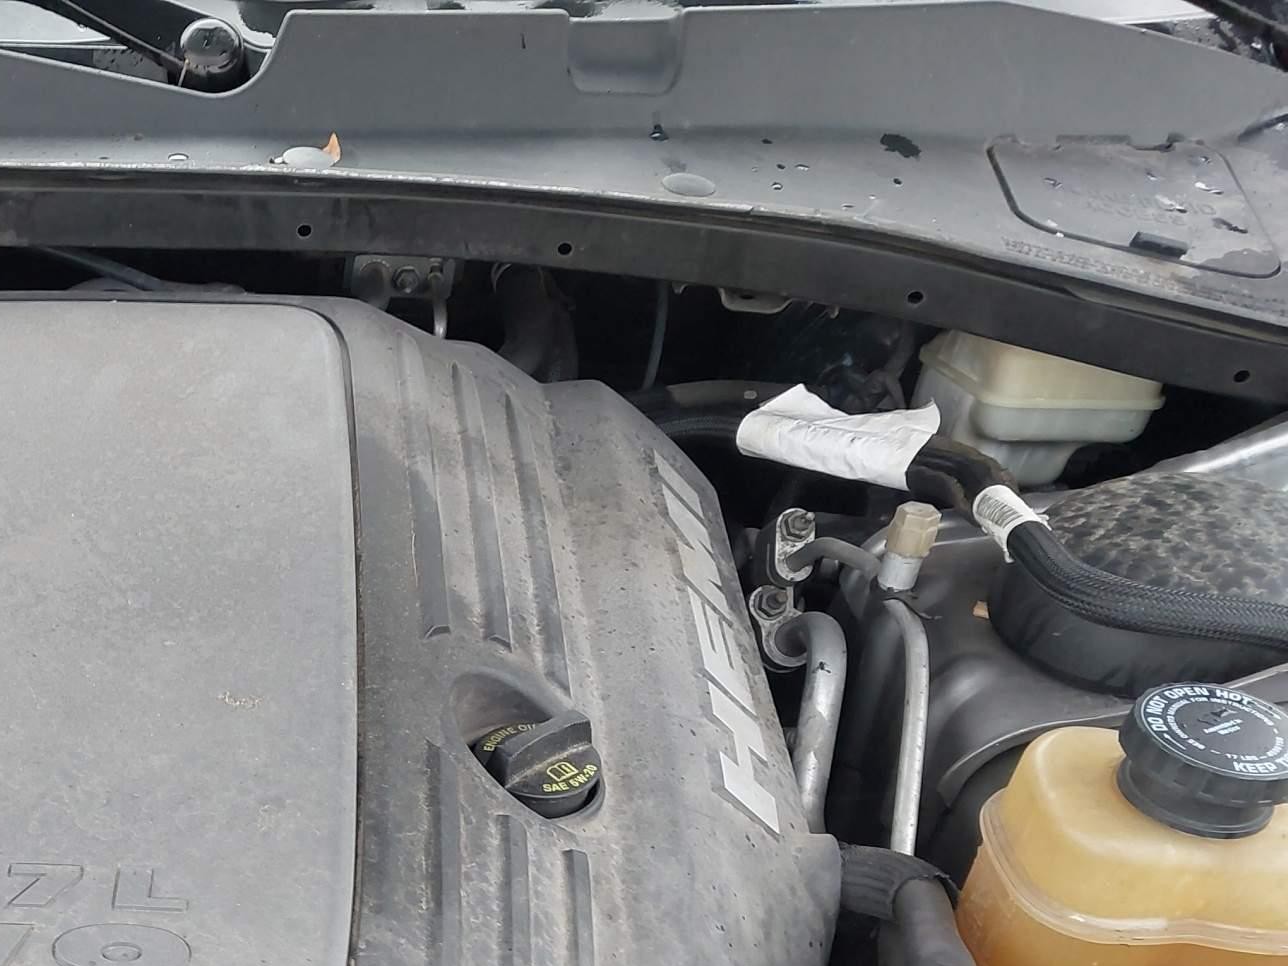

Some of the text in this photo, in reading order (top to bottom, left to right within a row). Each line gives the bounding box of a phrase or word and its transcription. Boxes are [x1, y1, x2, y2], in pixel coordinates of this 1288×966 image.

[653, 447, 781, 835] HEMI
[1146, 687, 1253, 731] DO NOT OPEN HOT
[483, 726, 517, 752] ENGINE
[542, 764, 598, 792] SAE 5W-20
[1232, 761, 1277, 773] KEEP
